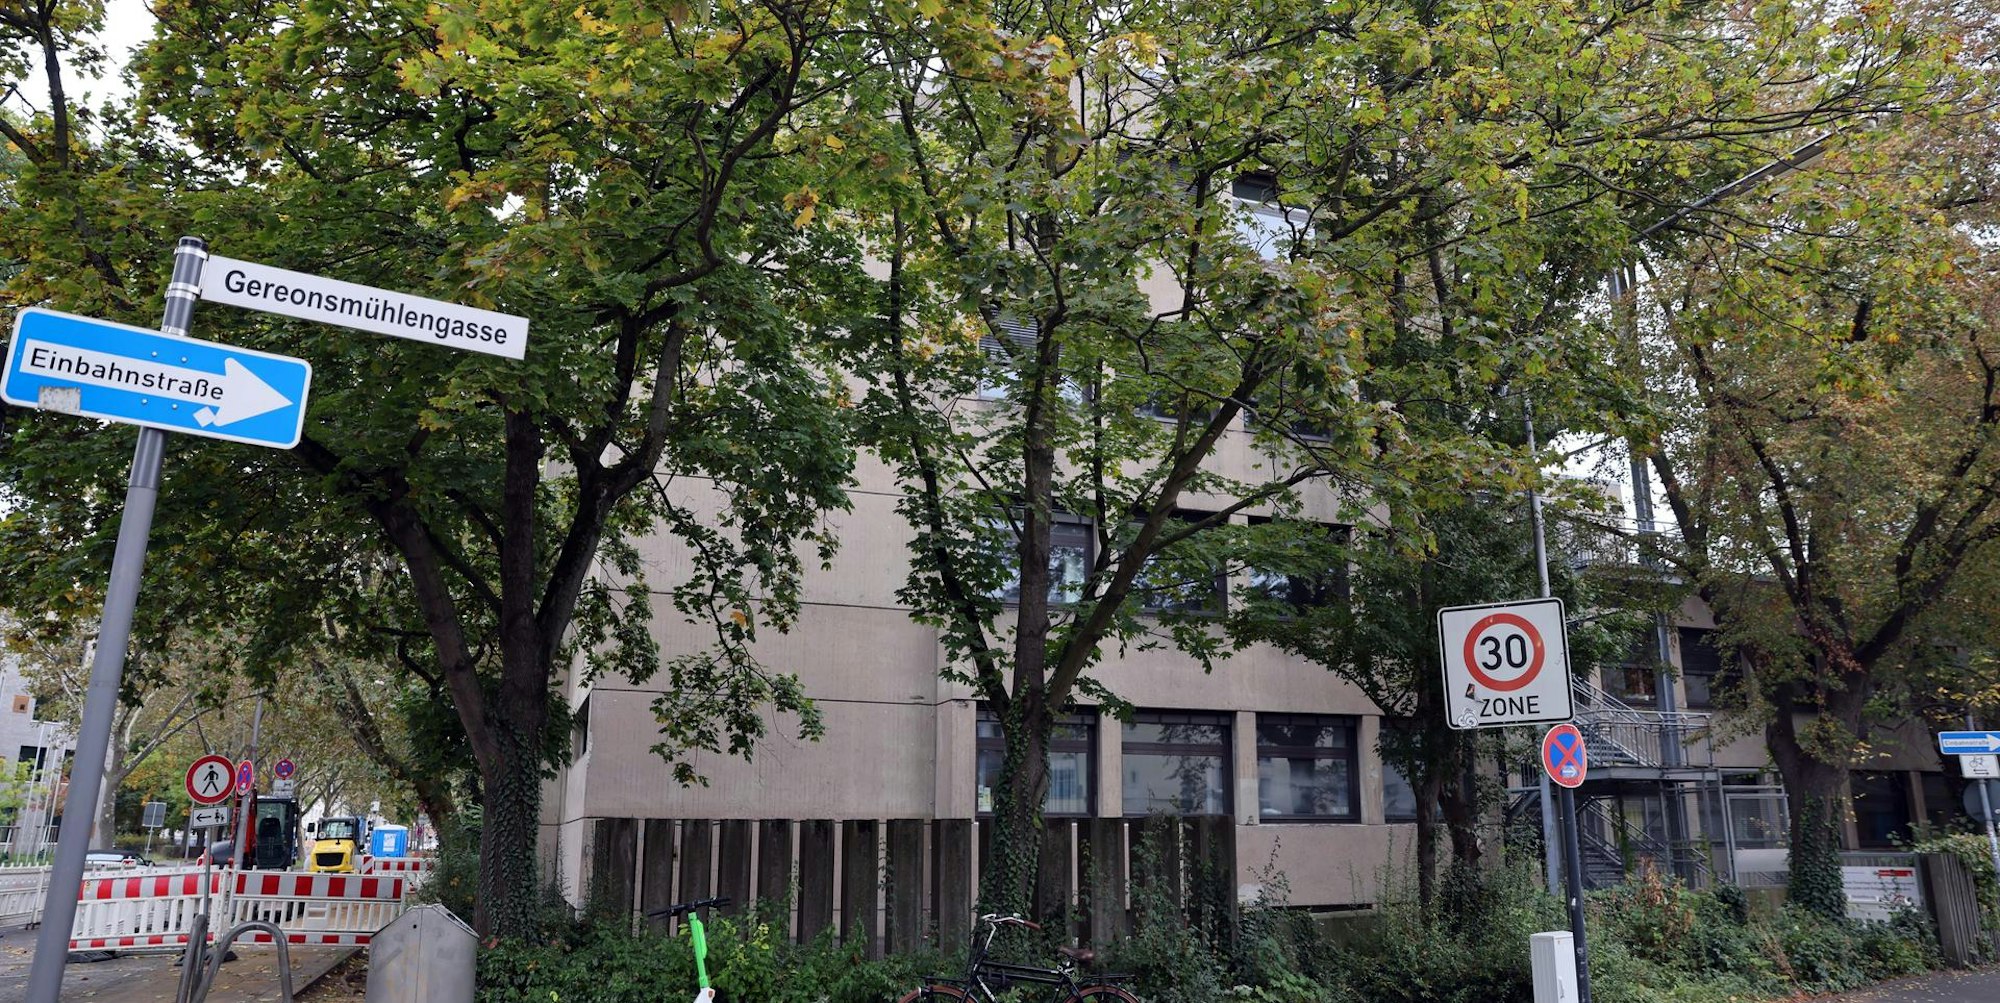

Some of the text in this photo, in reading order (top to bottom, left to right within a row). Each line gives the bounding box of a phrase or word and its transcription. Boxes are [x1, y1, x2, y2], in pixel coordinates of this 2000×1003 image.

[224, 269, 508, 345] Gereonsmühlengasse
[30, 347, 224, 401] Einbahnstraße
[1480, 634, 1528, 670] 30
[1480, 695, 1541, 717] ZONE
